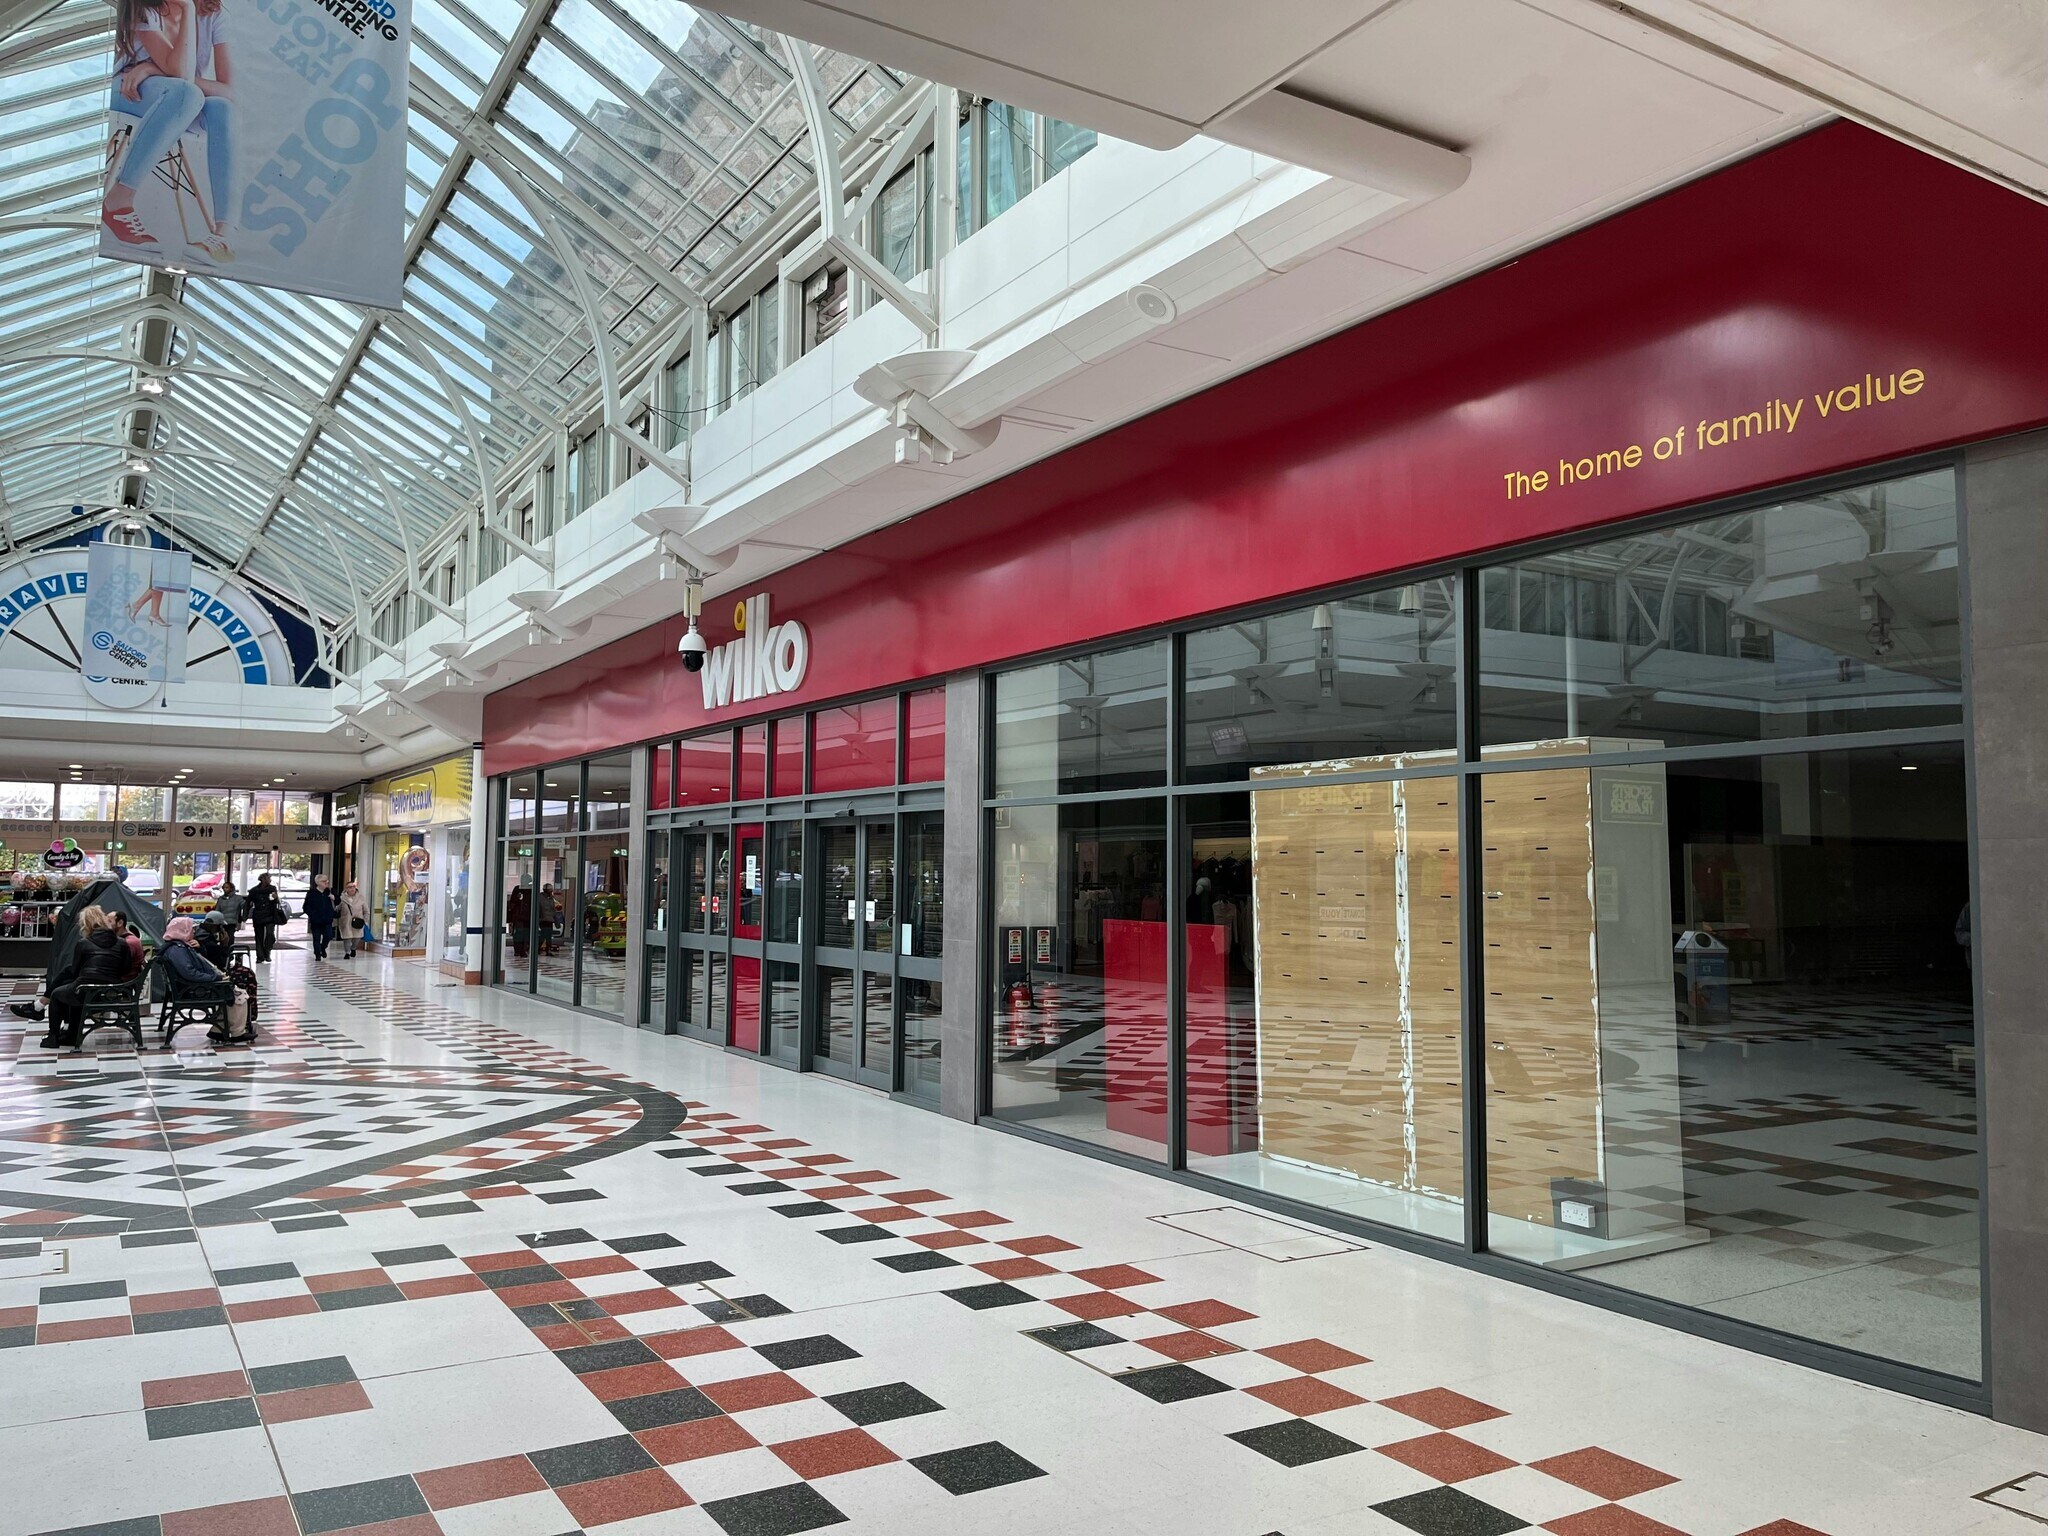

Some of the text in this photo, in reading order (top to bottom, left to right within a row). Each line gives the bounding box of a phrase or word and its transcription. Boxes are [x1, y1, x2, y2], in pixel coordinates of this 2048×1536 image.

[313, 0, 367, 40] NTRE.
[363, 0, 396, 20] RD
[269, 34, 331, 86] EAT
[241, 58, 403, 257] SHOP
[1503, 368, 1926, 500] The home of family value
[108, 650, 136, 670] CENTRE.
[111, 644, 149, 669] SHOPPING
[115, 639, 148, 661] SALFORD
[700, 592, 809, 710] wilko
